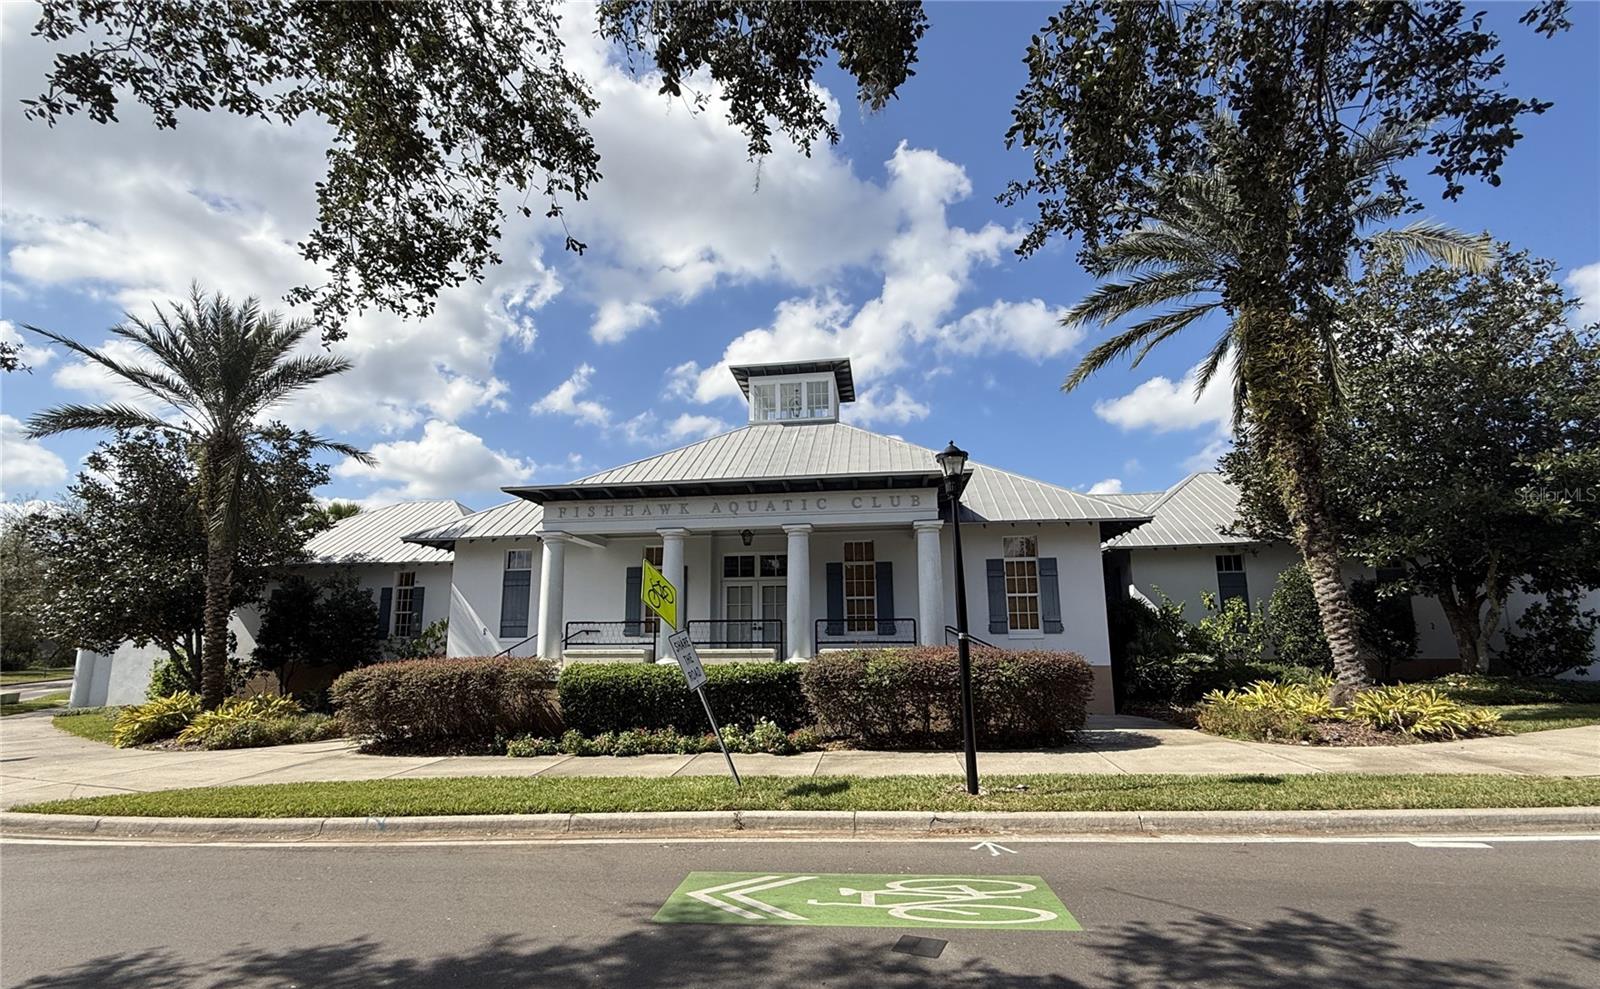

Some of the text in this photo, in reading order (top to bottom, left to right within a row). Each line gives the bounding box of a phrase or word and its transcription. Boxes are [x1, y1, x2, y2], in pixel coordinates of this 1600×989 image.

[558, 494, 922, 518] FISHHAWK AQUATIC CLUB
[673, 637, 691, 652] SHARE
[682, 652, 694, 665] THE
[687, 666, 702, 681] ROAD
